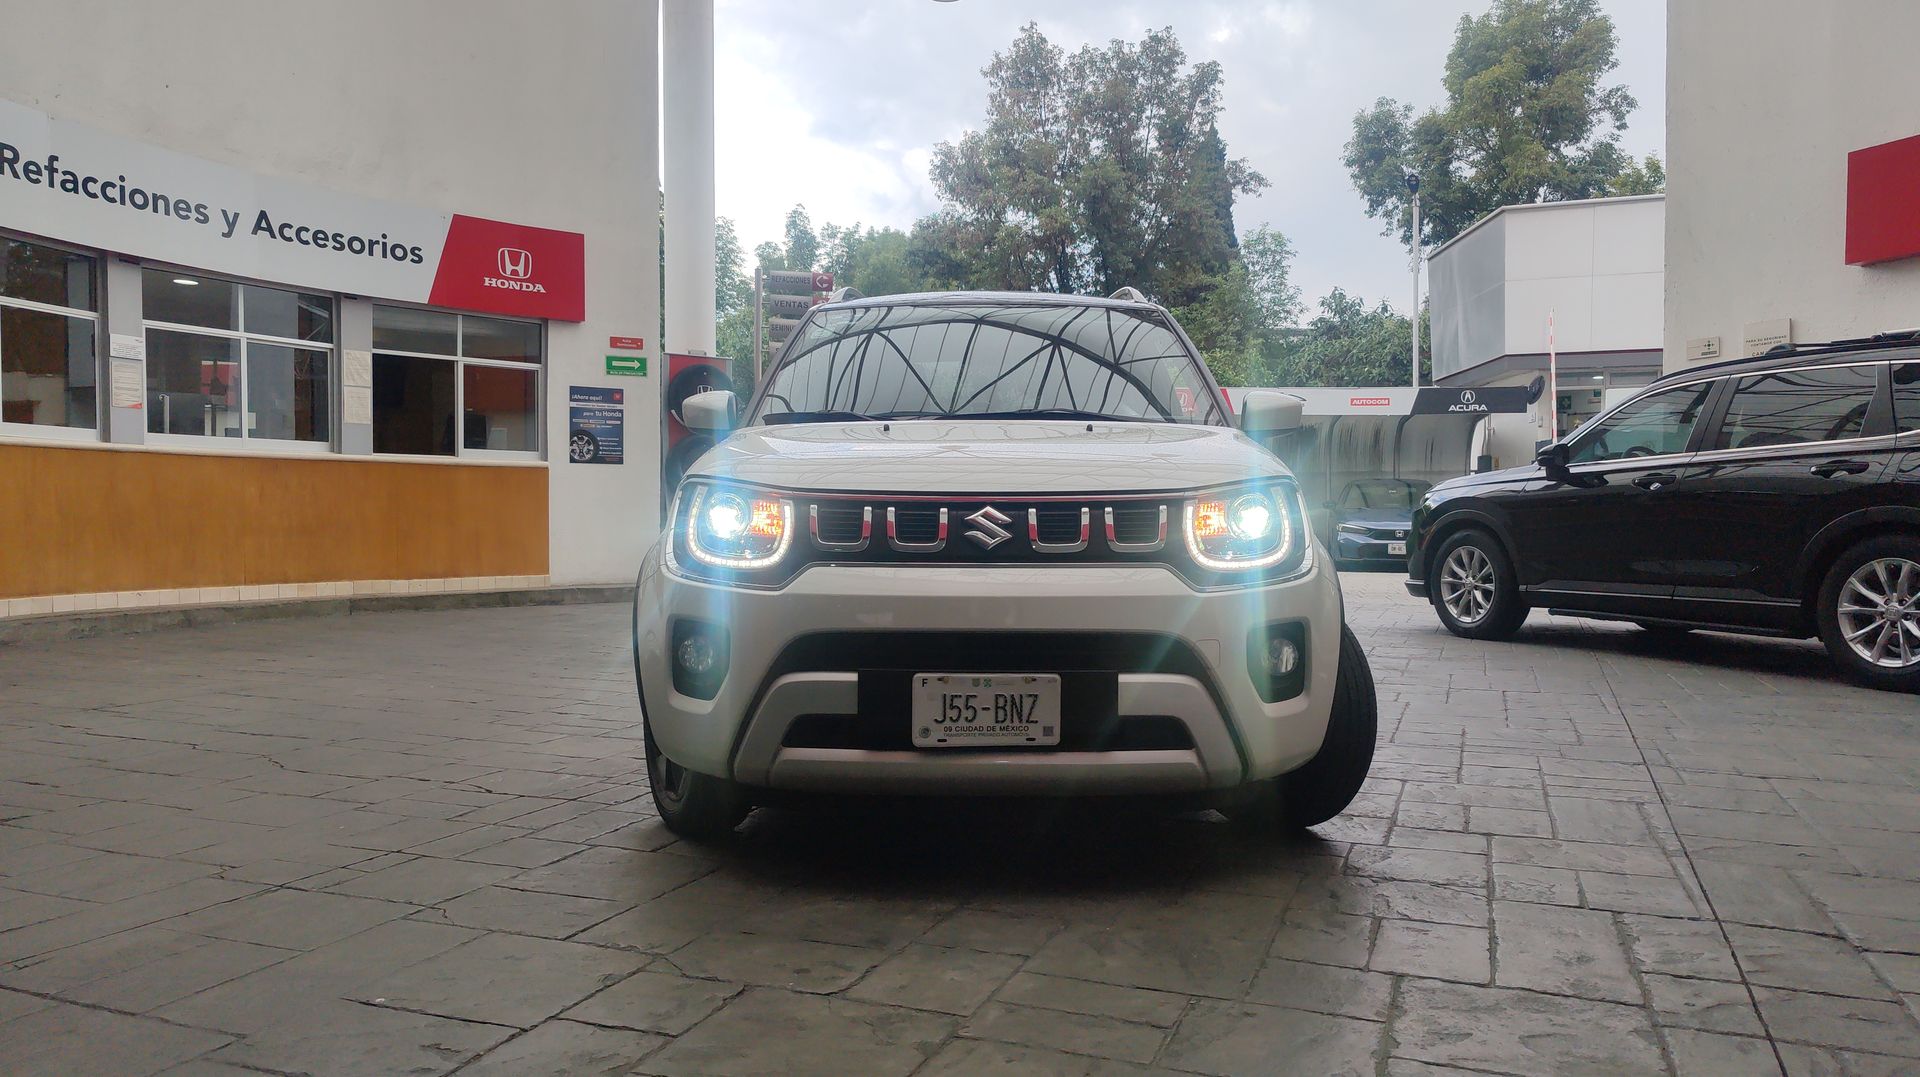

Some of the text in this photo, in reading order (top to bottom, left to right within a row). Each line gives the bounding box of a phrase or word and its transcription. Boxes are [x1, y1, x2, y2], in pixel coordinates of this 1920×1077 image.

[0, 142, 424, 264] Refacciones y Accesorios
[771, 275, 811, 285] REFACCIONES
[484, 277, 547, 293] HONDA
[774, 300, 809, 309] VENTAS
[1448, 404, 1488, 412] ACURA
[921, 678, 928, 687] F
[934, 693, 1039, 724] J55-BNZ
[999, 724, 1030, 732] MÉXICO
